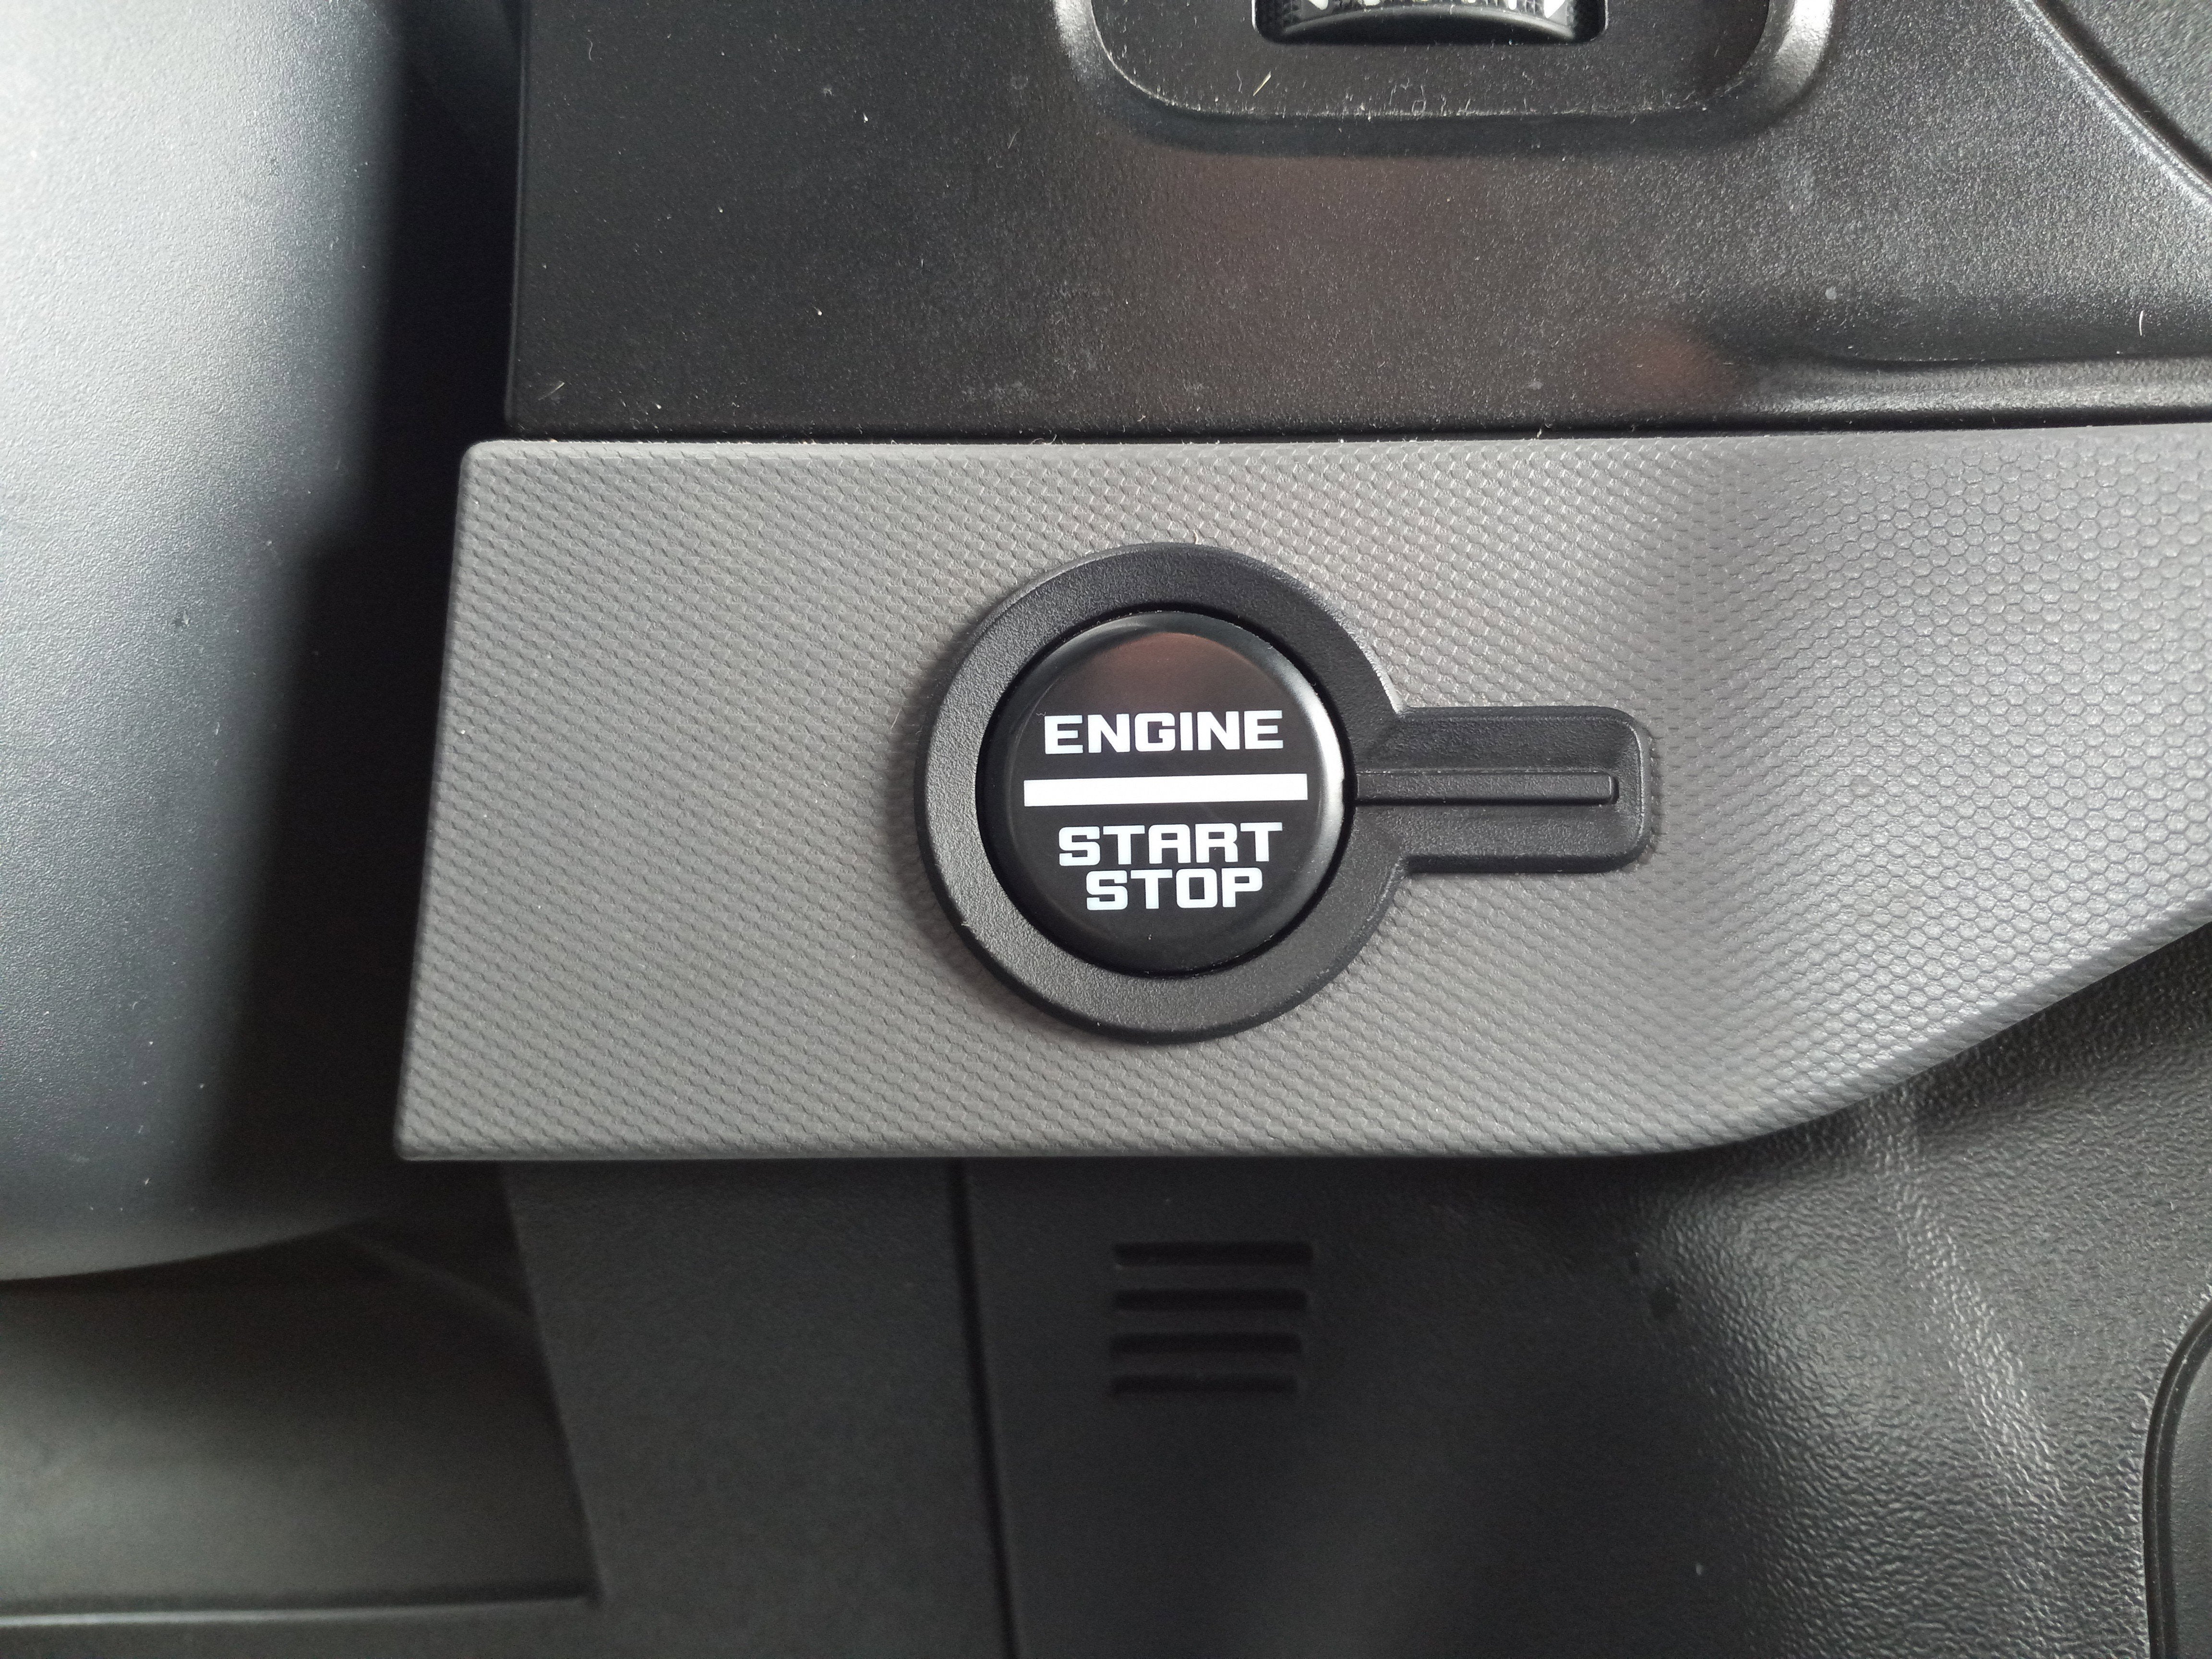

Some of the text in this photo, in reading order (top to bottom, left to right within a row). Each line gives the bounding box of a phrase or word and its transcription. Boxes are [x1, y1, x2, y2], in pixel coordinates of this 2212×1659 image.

[1044, 710, 1284, 755] ENGINE
[1058, 822, 1283, 866] START
[1086, 867, 1263, 911] STOP
